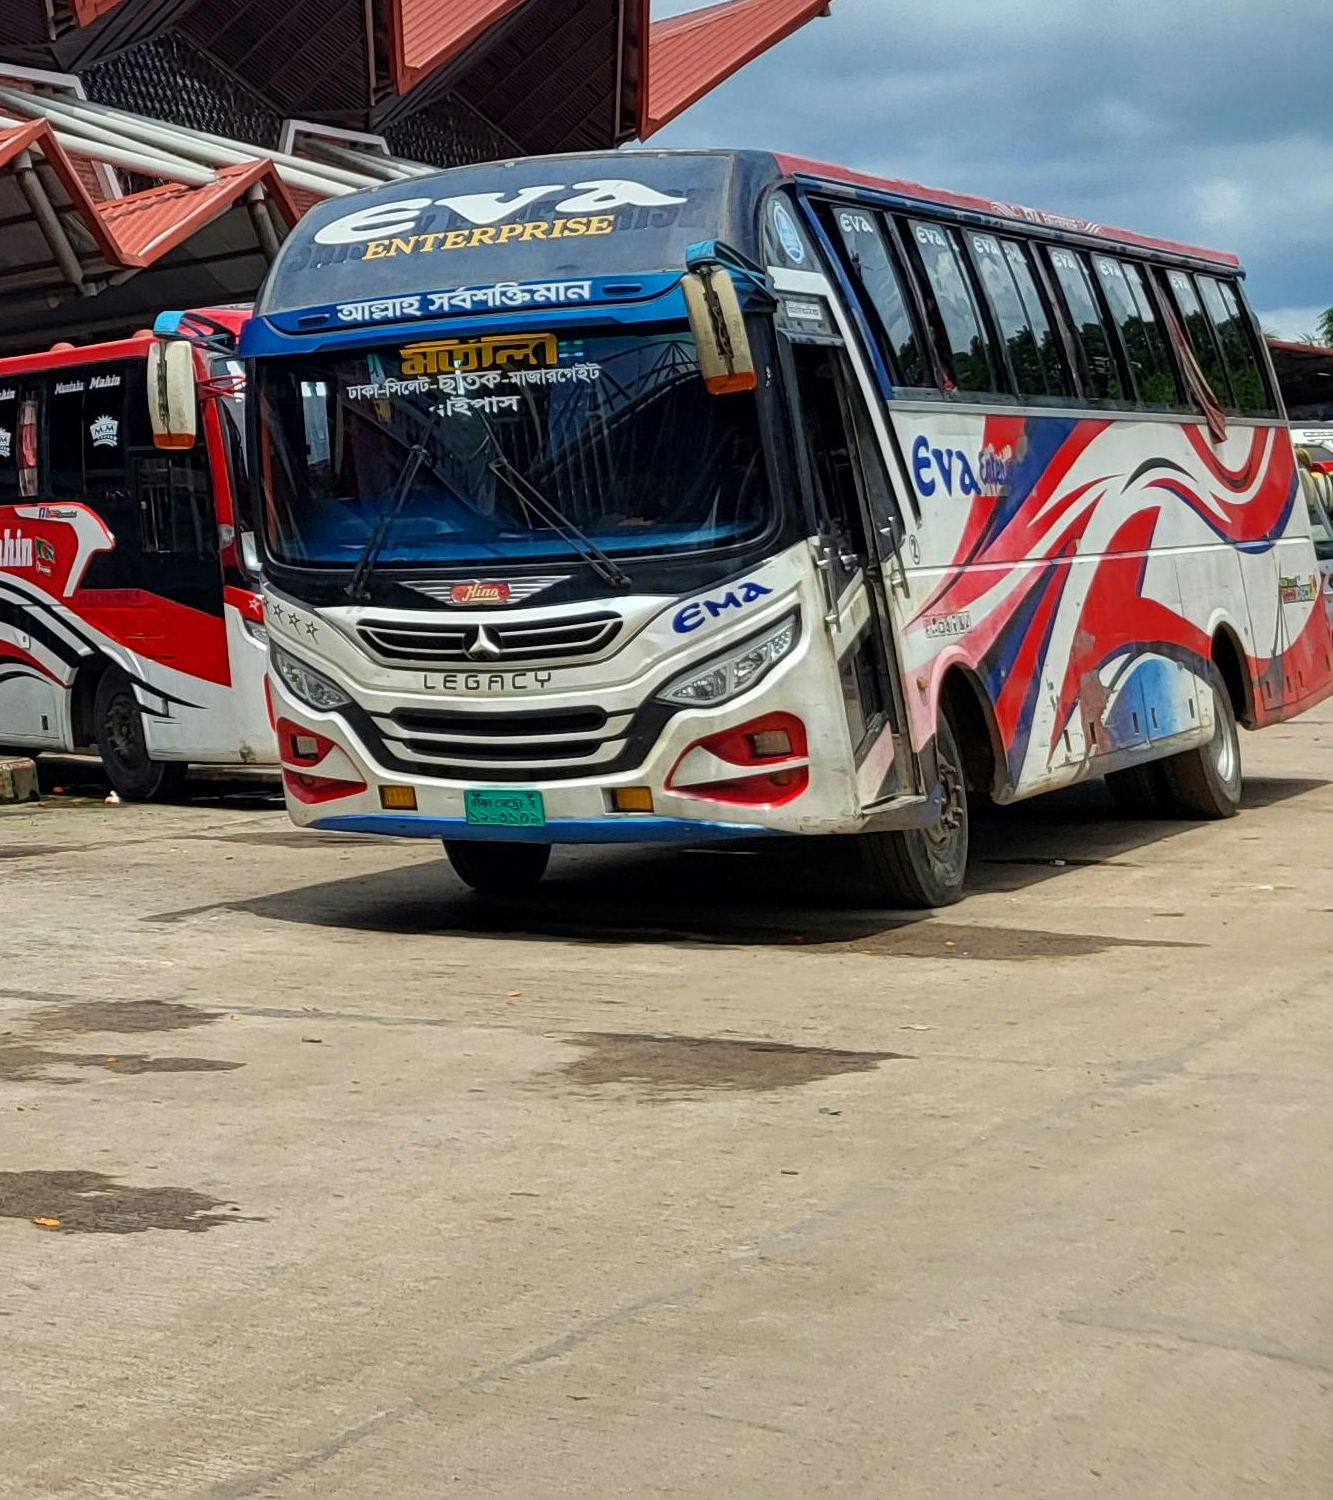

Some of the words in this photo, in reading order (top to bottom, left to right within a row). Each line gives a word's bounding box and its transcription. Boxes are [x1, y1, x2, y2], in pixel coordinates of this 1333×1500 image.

[361, 214, 615, 261] ENTERPRISE
[336, 295, 423, 322] আল্লাহ
[427, 280, 593, 313] সর্বশক্তিমান
[89, 374, 122, 390] Mahin
[461, 583, 501, 602] Hino
[423, 671, 552, 691] LEGACY
